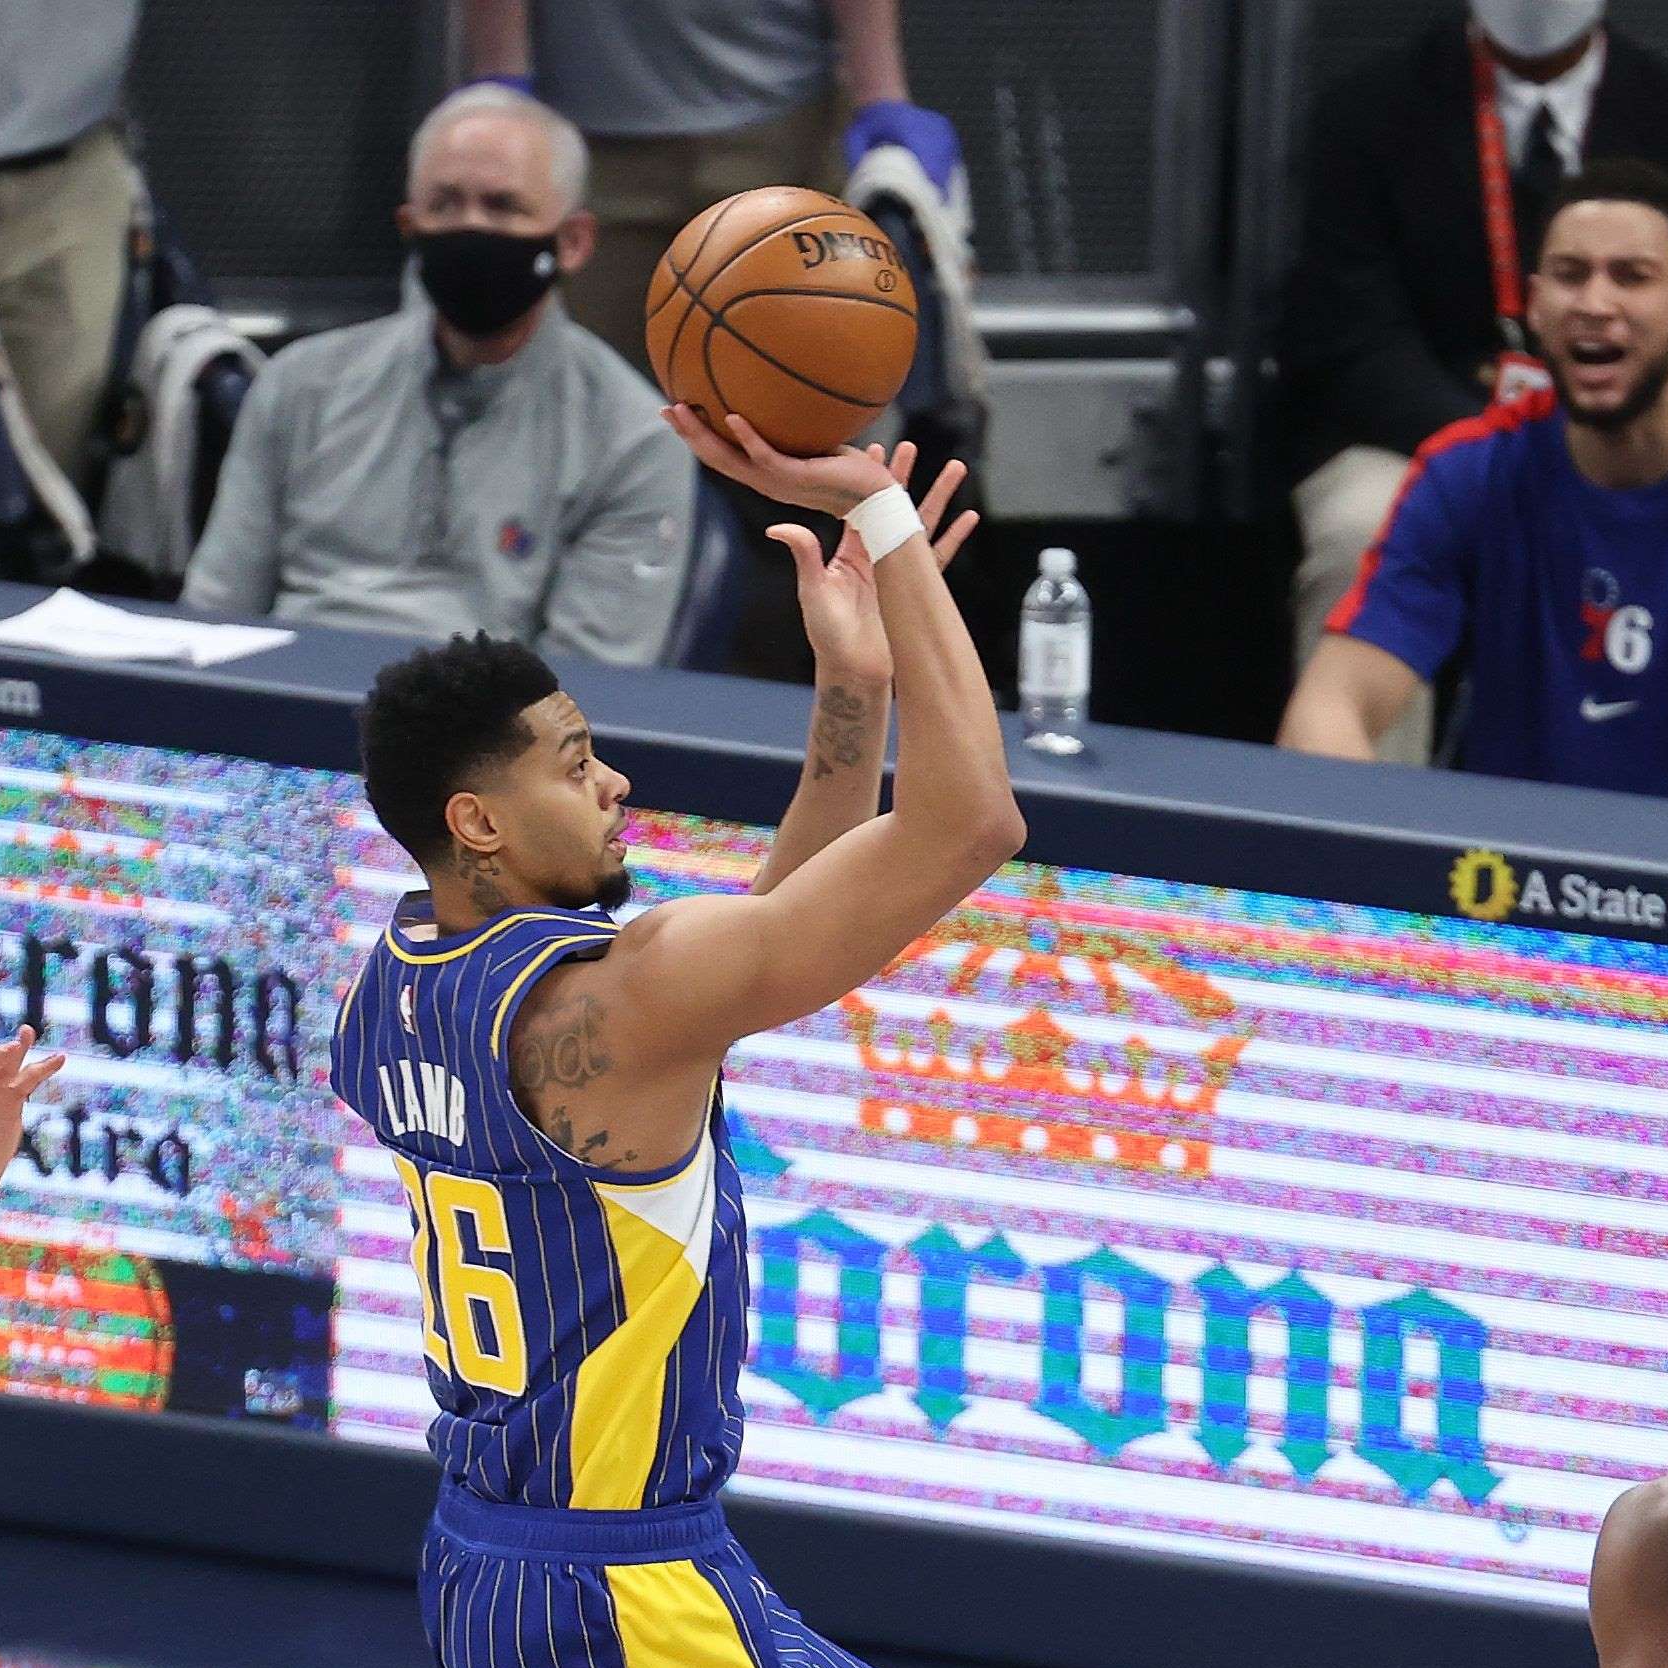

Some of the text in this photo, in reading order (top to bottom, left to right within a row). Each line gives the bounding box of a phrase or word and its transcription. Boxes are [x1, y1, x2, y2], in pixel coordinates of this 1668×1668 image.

[1579, 600, 1655, 675] 76
[1518, 876, 1554, 914] A
[1560, 872, 1668, 931] State
[377, 1059, 467, 1148] LAMB
[726, 1105, 1504, 1506] orona
